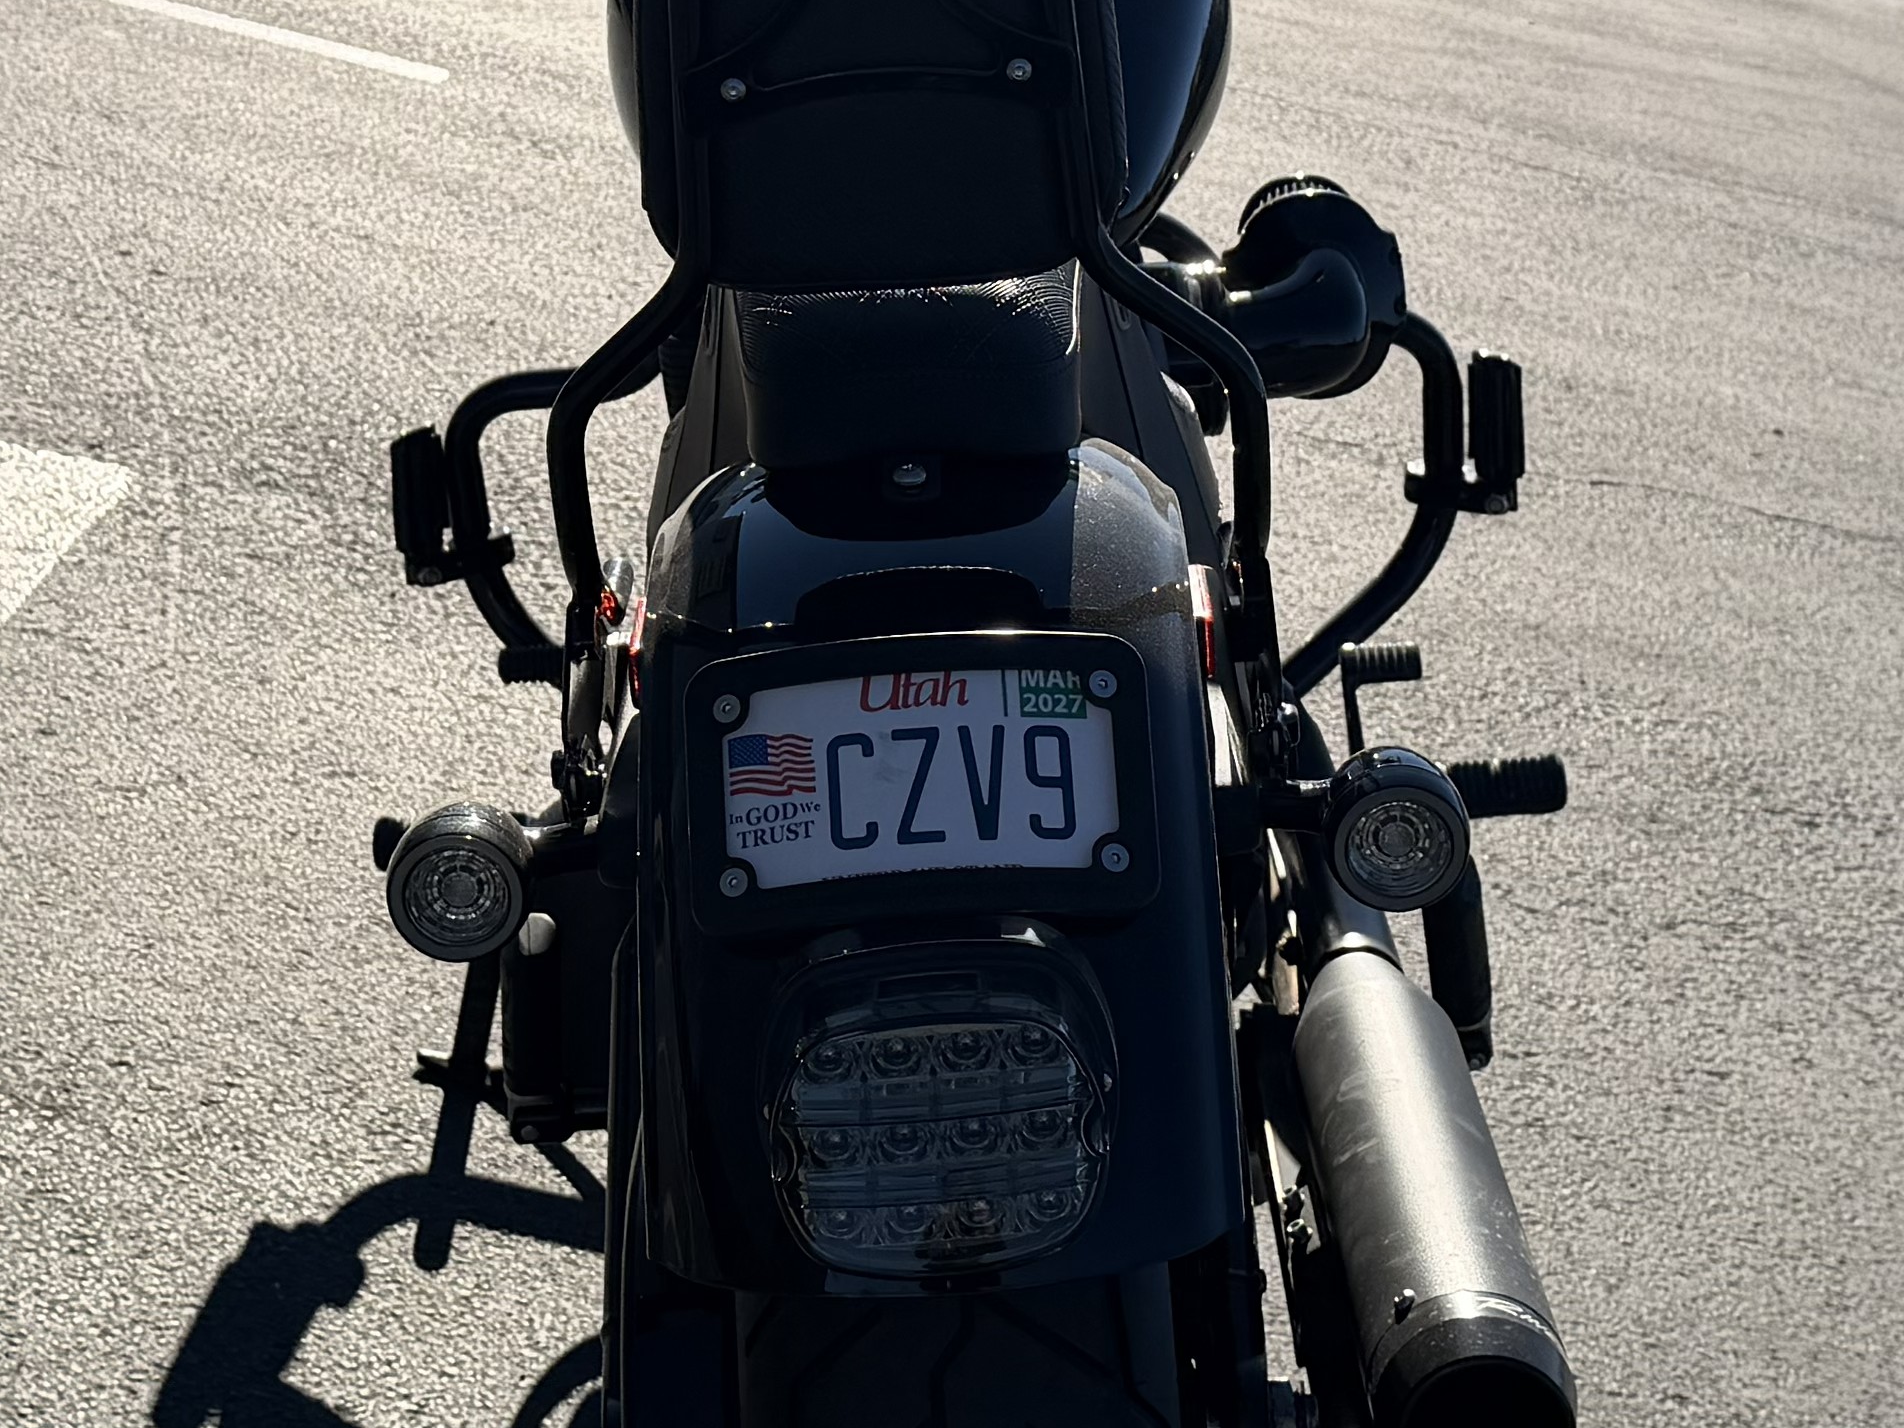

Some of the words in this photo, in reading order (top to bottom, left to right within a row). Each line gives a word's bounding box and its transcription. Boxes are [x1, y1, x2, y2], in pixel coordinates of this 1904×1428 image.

[859, 670, 969, 713] Utah
[1022, 693, 1084, 714] 2027
[826, 725, 1077, 850] CZV9
[729, 813, 744, 825] In
[745, 801, 798, 826] GOD
[799, 801, 821, 813] We
[736, 820, 815, 849] TRUST
